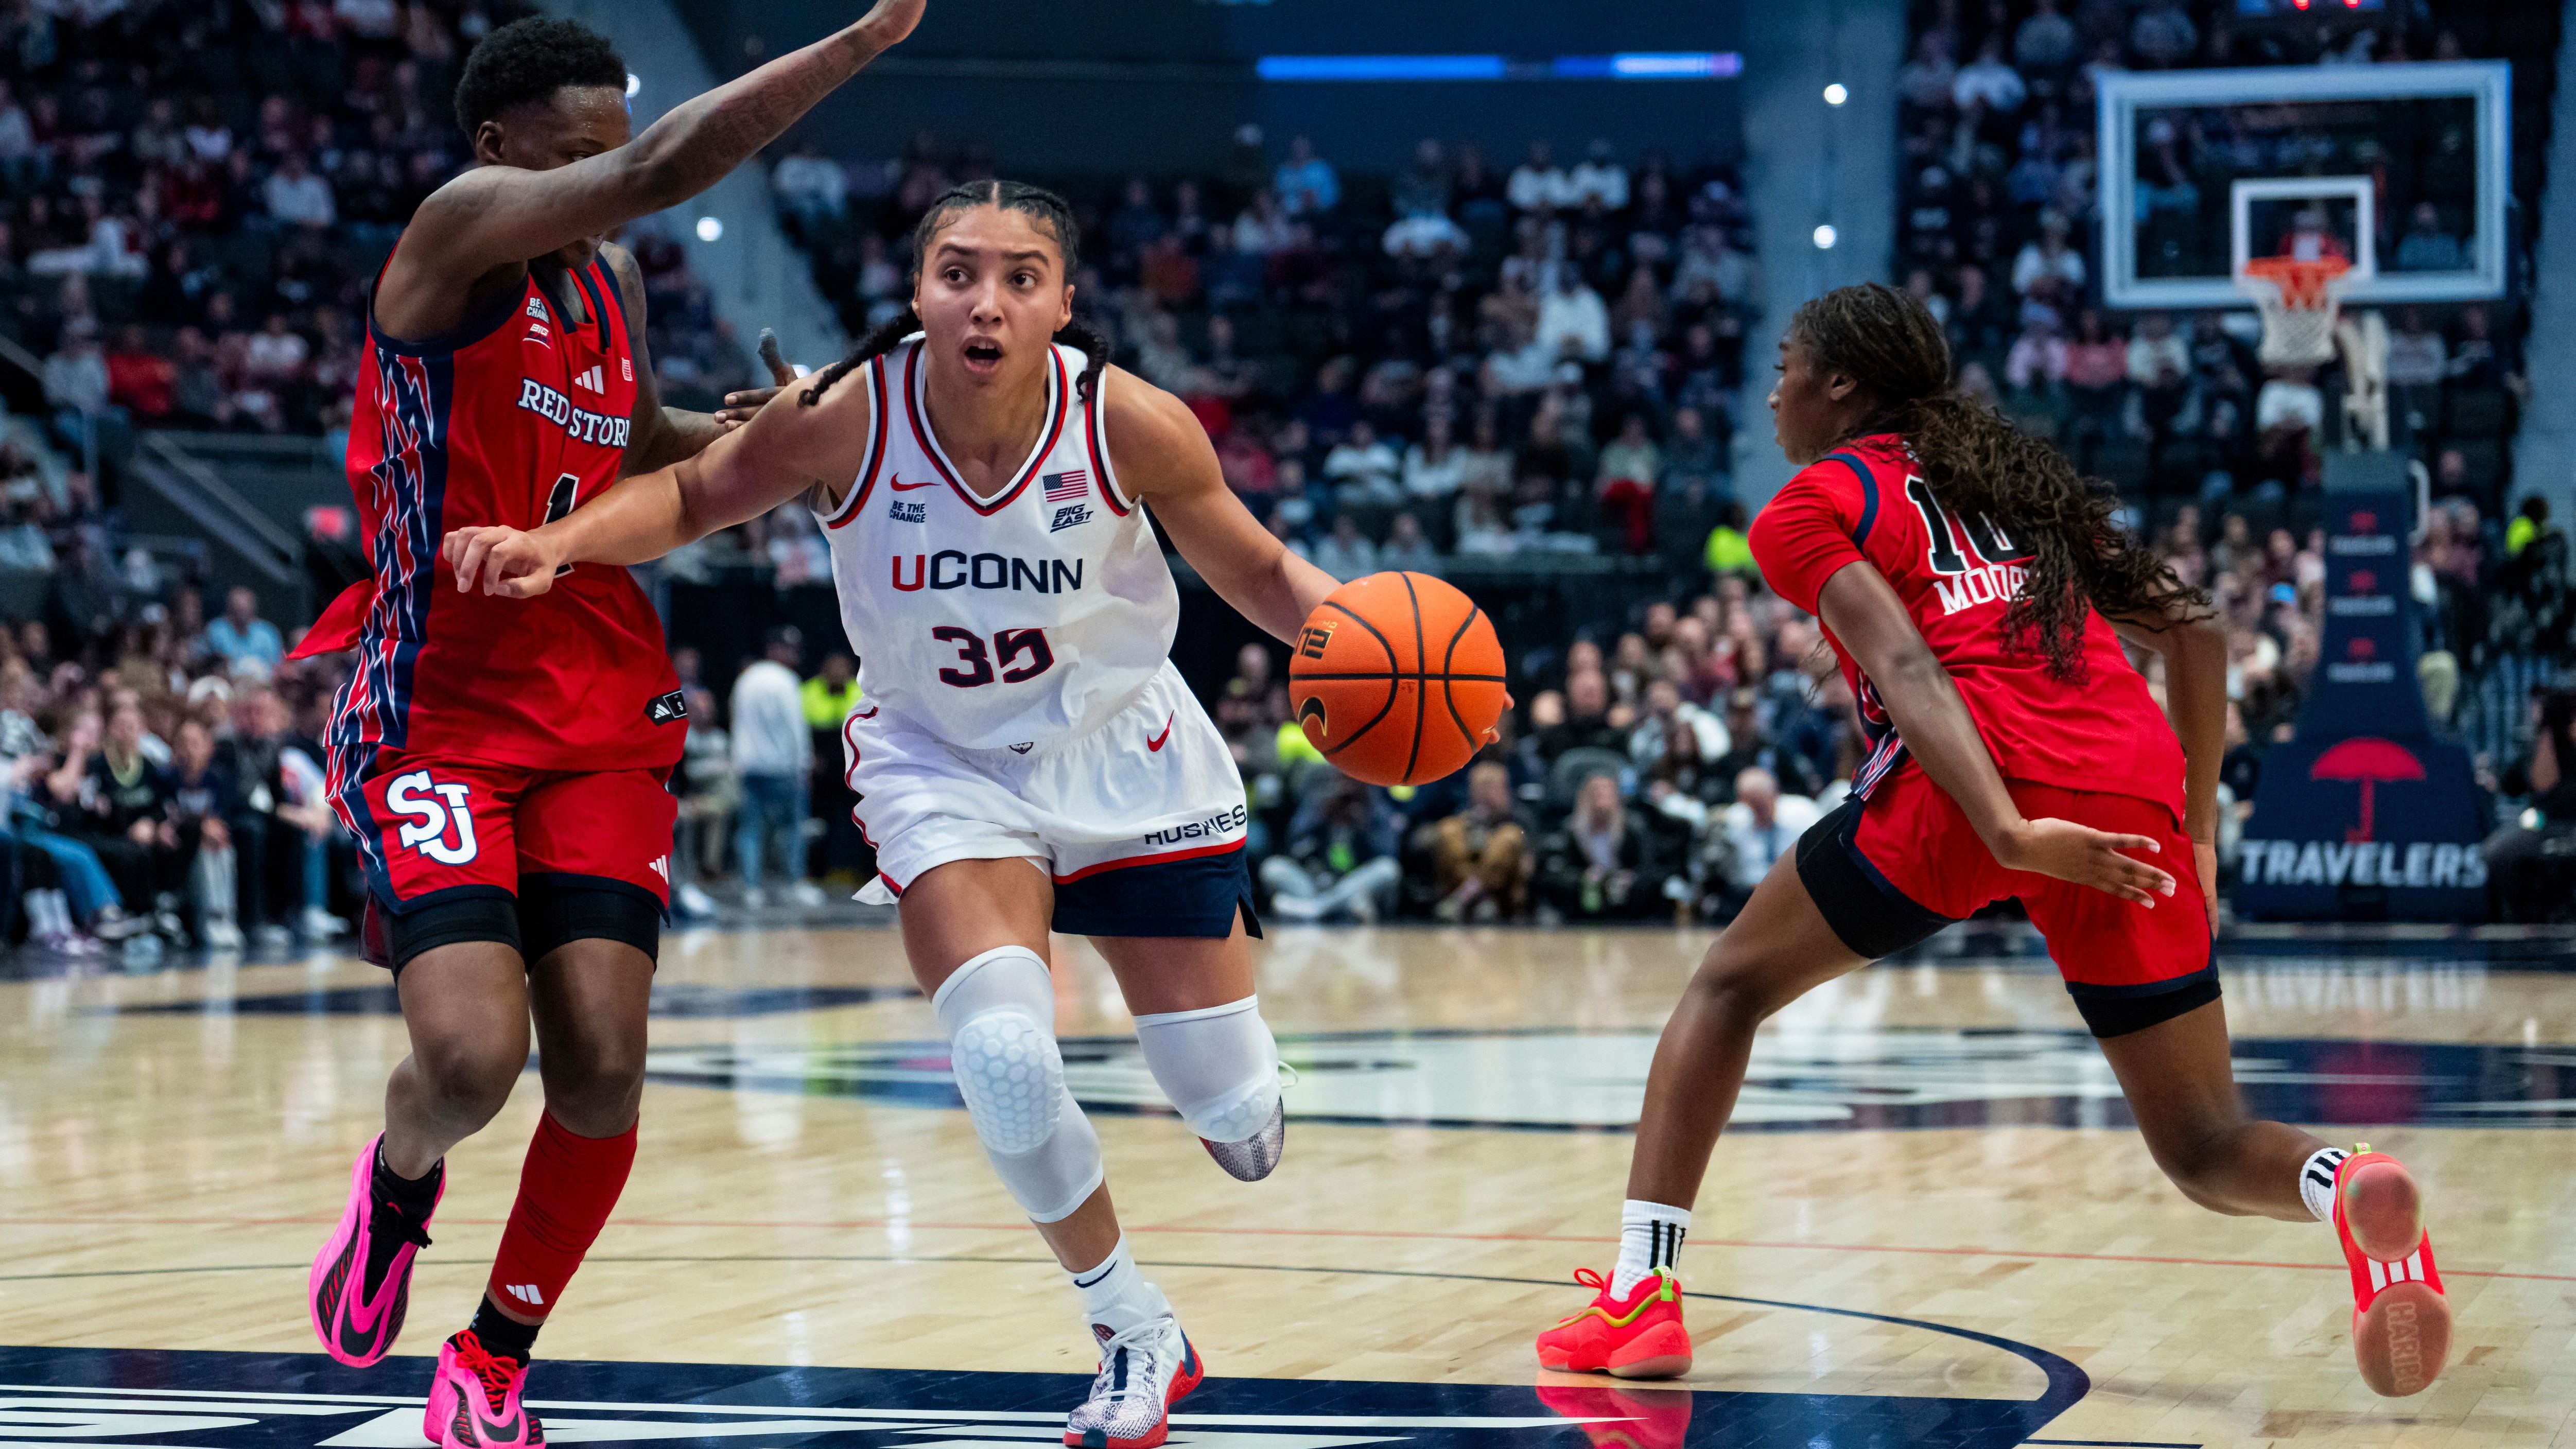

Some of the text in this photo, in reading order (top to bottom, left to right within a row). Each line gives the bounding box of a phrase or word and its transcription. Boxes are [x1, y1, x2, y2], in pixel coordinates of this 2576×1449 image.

[530, 298, 541, 308] BE
[530, 324, 549, 337] BIG
[518, 378, 570, 426] RED
[890, 509, 926, 523] CHANGE
[892, 500, 926, 513] BE THE
[1052, 511, 1094, 528] EAST
[1055, 503, 1086, 518] BIG
[892, 550, 1083, 594] UCONN
[1933, 565, 2041, 616] MOOR
[932, 626, 1054, 688] 35
[1144, 804, 1247, 845] HUSKIES
[2239, 839, 2490, 888] TRAVELERS
